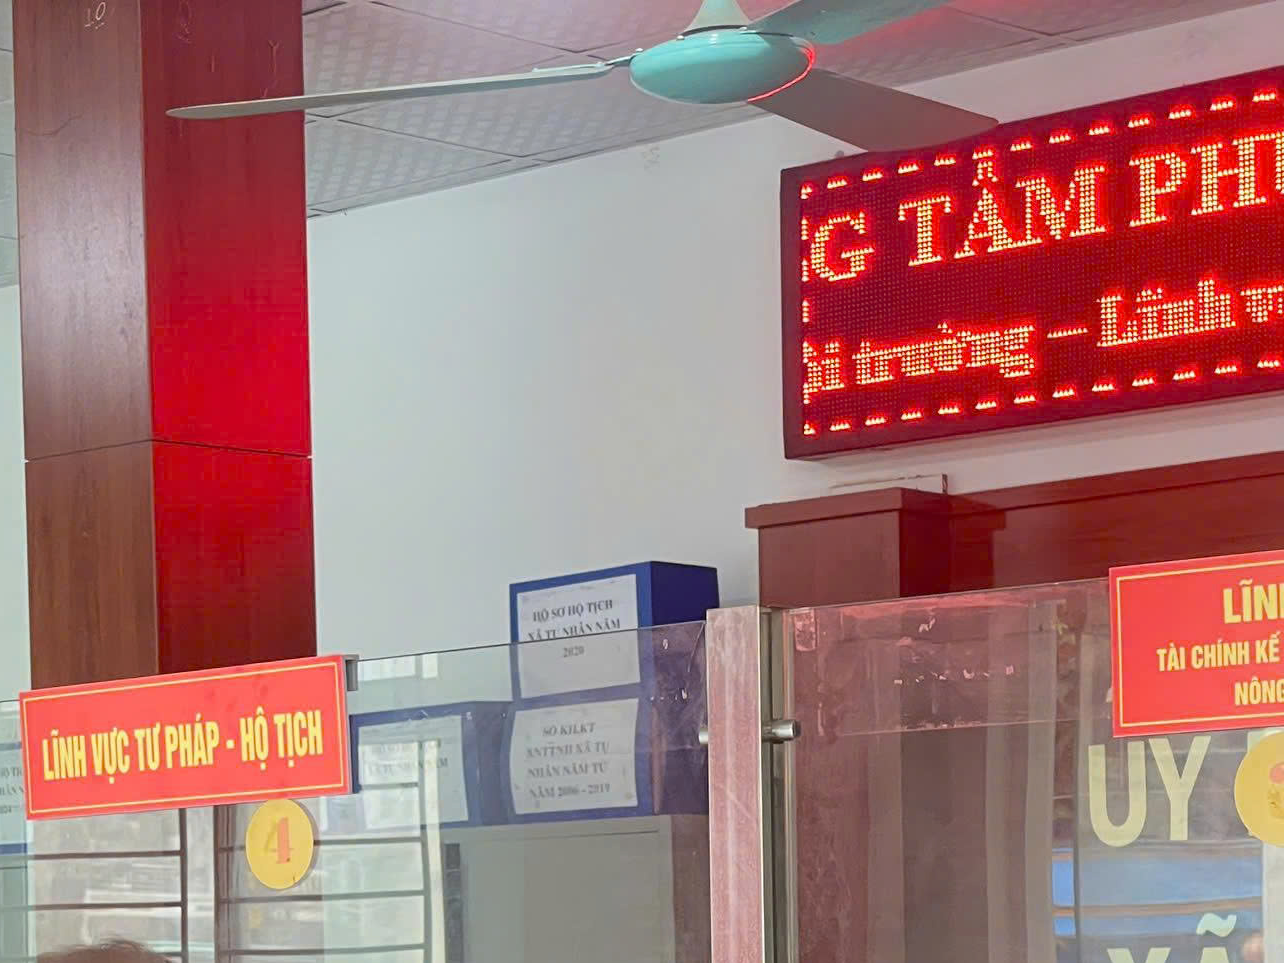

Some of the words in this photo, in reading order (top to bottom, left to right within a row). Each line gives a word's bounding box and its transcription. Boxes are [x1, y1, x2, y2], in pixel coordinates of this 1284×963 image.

[1156, 642, 1186, 672] TÀI
[1191, 638, 1250, 669] CHÍNH
[1255, 631, 1281, 664] KẾ
[42, 729, 87, 781] LĨNH
[91, 727, 130, 785] VỰC
[134, 722, 161, 772] TƯ
[165, 713, 220, 769] PHÁP
[239, 705, 269, 771] HỘ
[274, 709, 324, 768] TỊCH
